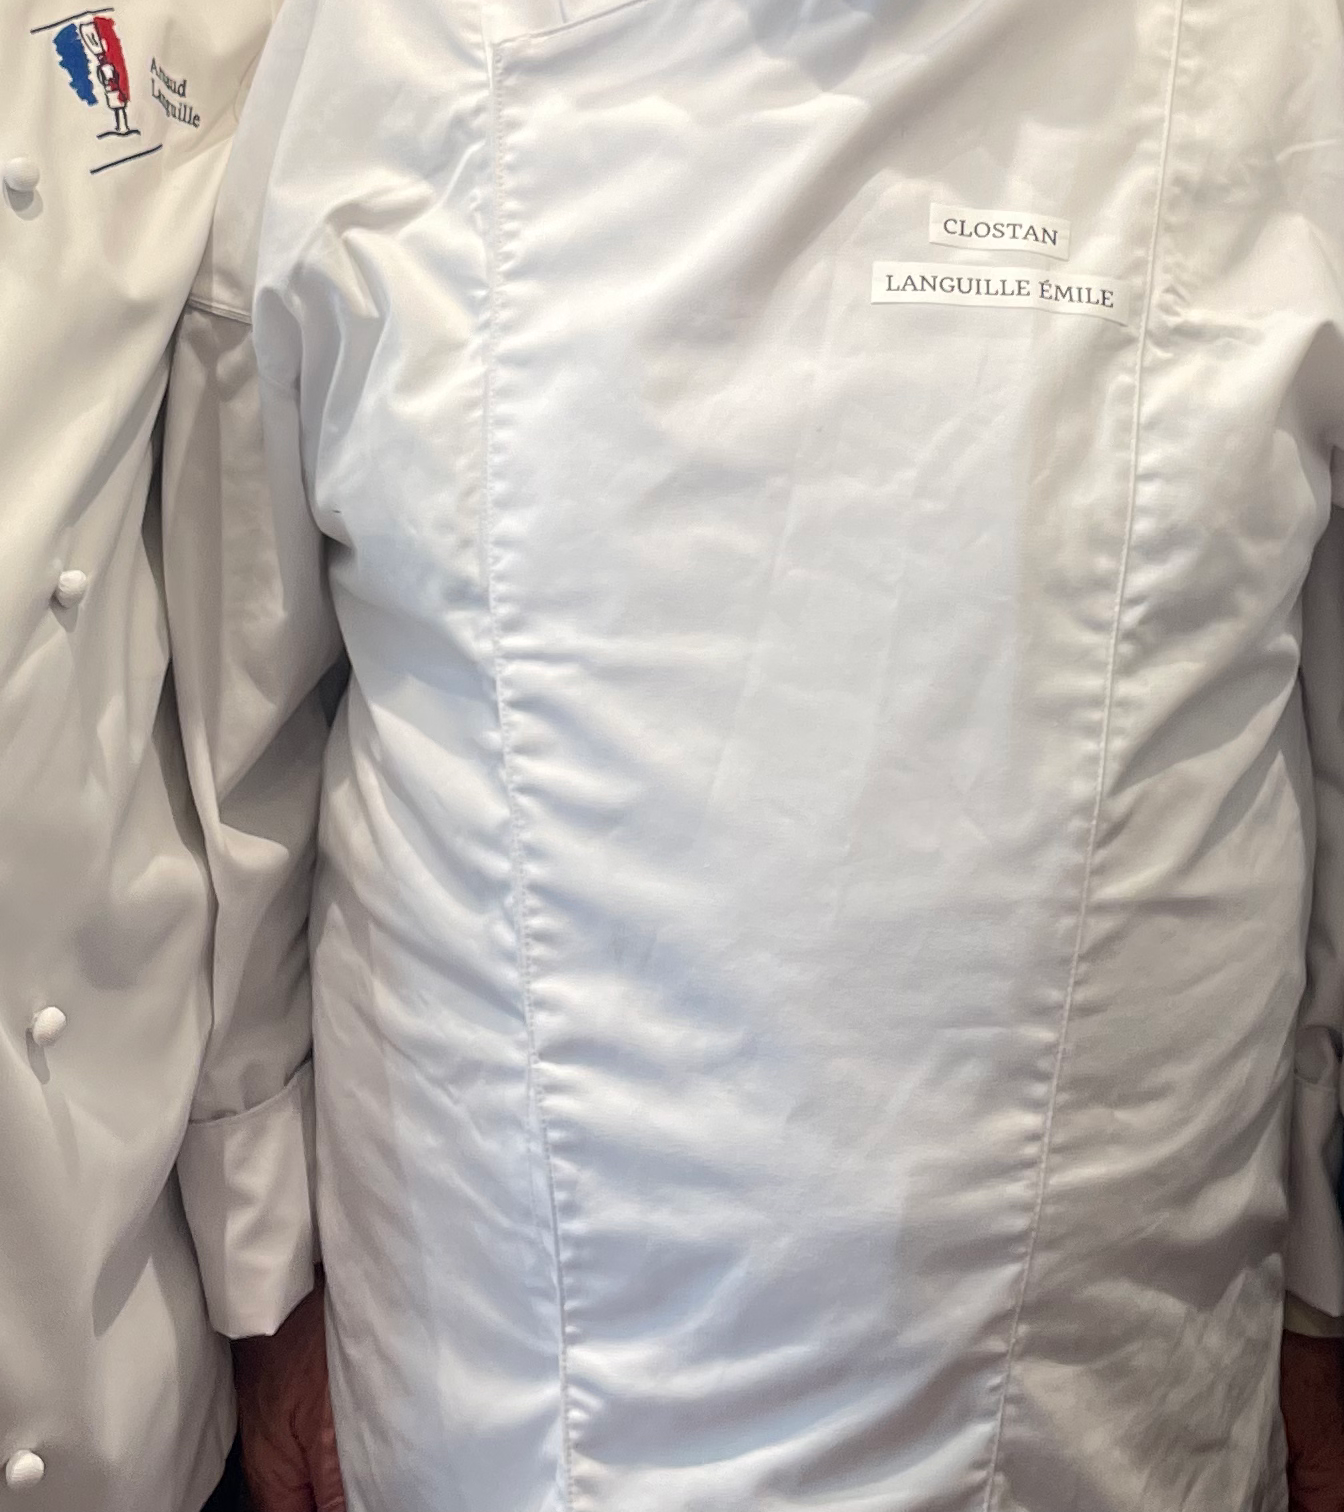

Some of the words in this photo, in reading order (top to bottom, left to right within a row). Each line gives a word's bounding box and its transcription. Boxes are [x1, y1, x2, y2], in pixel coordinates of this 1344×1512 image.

[943, 219, 1058, 245] CLOSTAN
[886, 274, 1030, 297] LANGUILLE
[1038, 280, 1114, 308] ÉMILE
